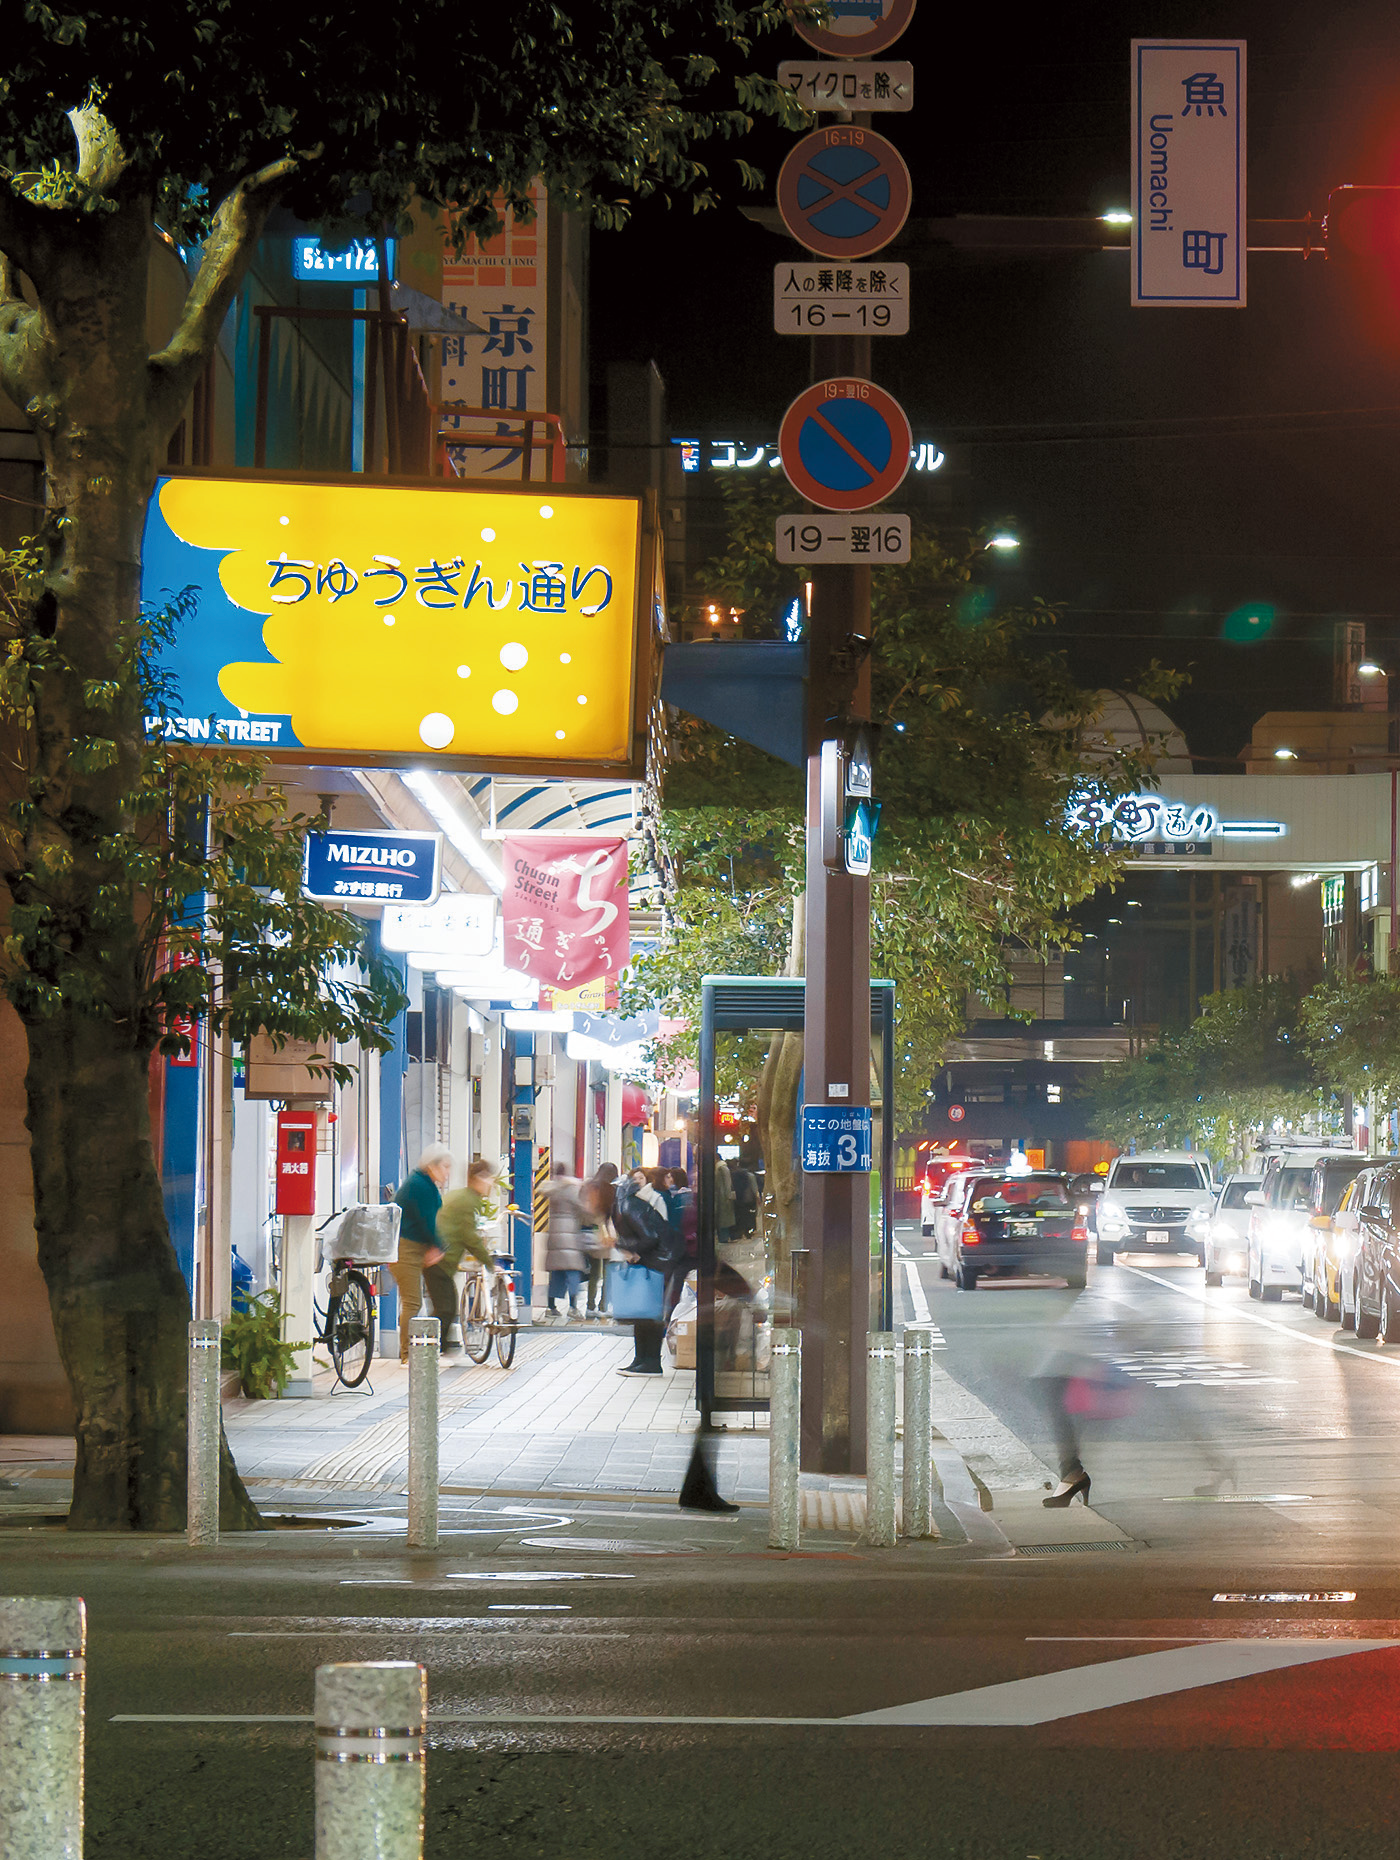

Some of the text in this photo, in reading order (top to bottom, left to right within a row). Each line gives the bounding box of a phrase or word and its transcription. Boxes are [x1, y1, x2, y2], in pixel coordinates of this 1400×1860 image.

[787, 71, 903, 100] マイクロを除く
[824, 130, 865, 146] 16-19
[1149, 114, 1174, 232] Uomachi
[1181, 72, 1229, 275] 魚町
[783, 268, 900, 294] 人の乗降を除く
[791, 304, 892, 327] 16-19
[783, 525, 903, 553] 19-翌16
[266, 552, 614, 617] ちゅうぎん通り
[214, 719, 283, 743] STREET
[327, 843, 417, 867] MIZUHO
[514, 859, 560, 888] Chugin
[333, 880, 403, 898] みずほ銀行
[514, 876, 559, 903] Street
[515, 917, 545, 970] 通り
[555, 930, 576, 982] ぎん
[808, 1118, 870, 1131] ここの地盤は
[282, 1162, 309, 1175] 消火器
